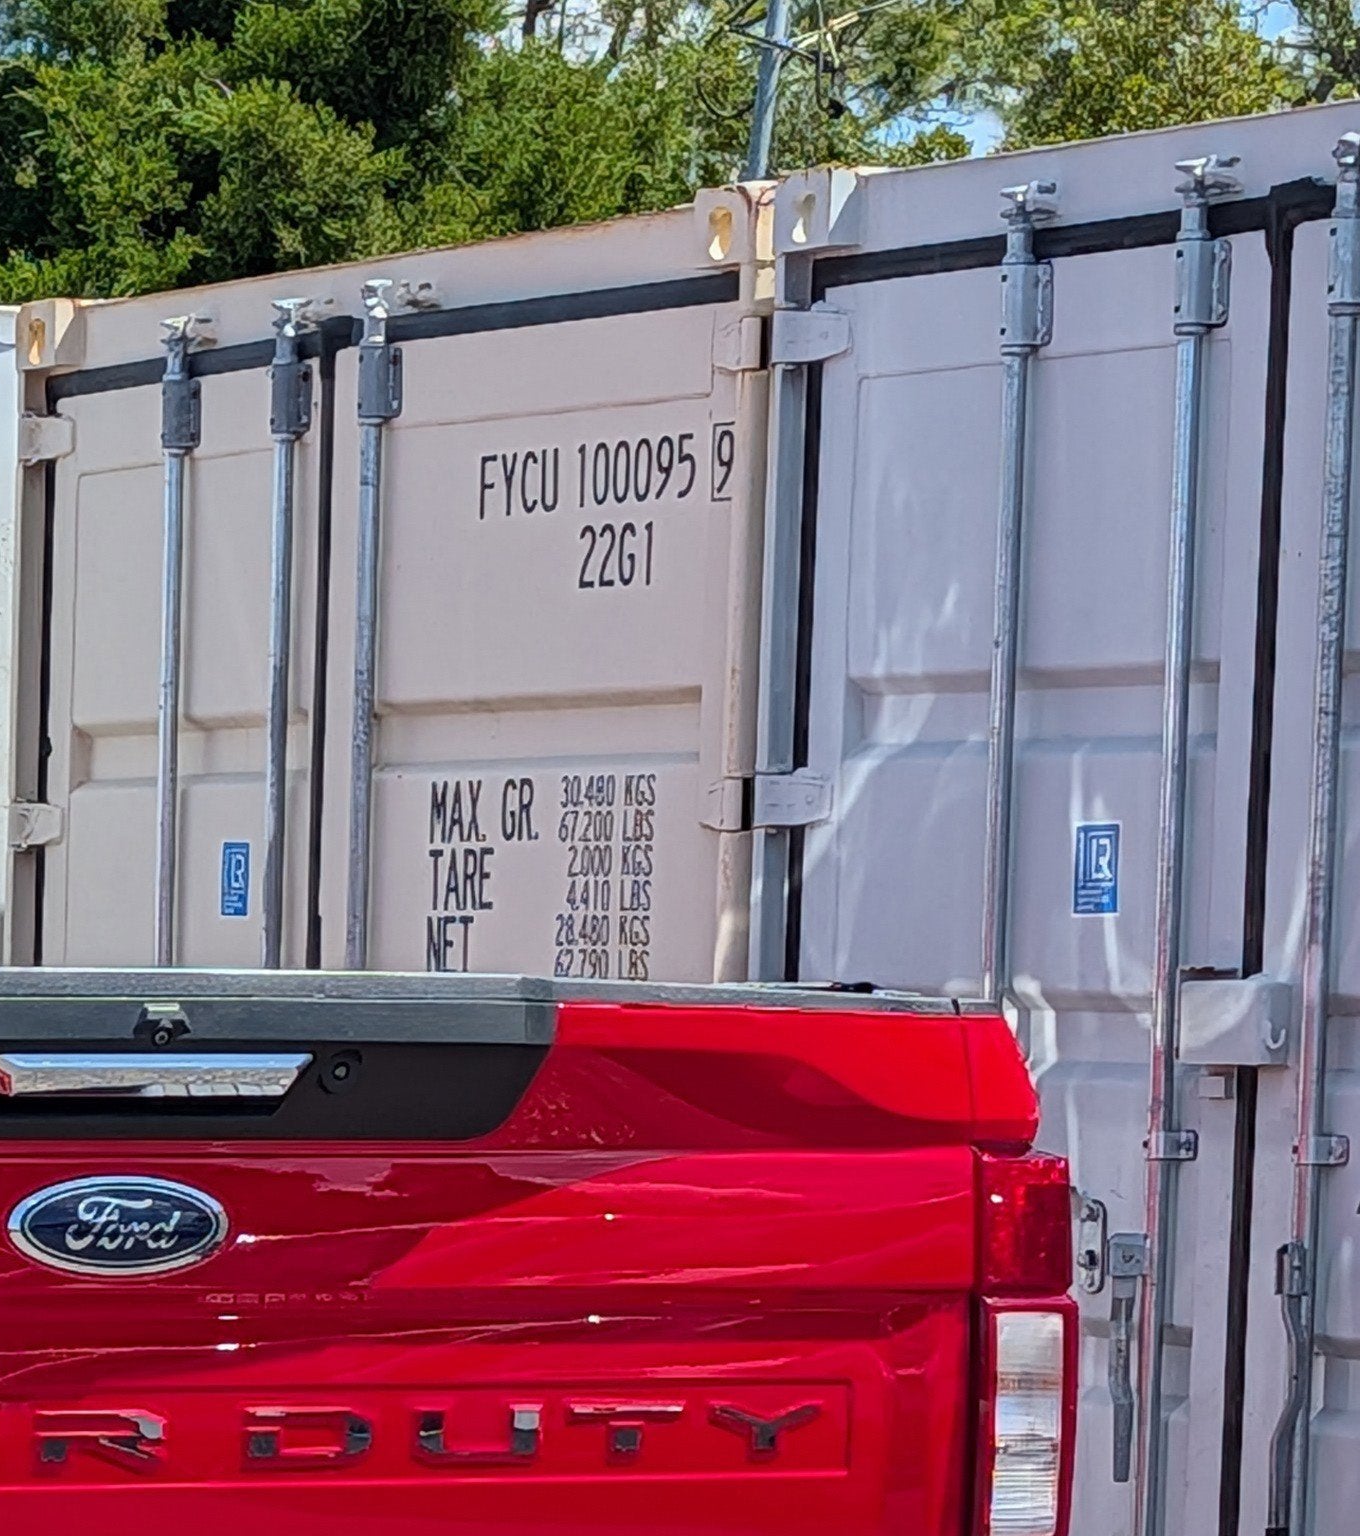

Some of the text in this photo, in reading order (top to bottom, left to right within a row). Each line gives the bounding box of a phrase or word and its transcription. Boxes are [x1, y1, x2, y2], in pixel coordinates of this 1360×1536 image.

[480, 430, 735, 519] FYCU 100095 9
[579, 520, 654, 588] 22G1
[430, 780, 487, 843] MAX.
[501, 778, 539, 841] GR.
[623, 774, 656, 806] KGS
[622, 809, 655, 842] LBS
[429, 847, 494, 911] TARE
[621, 845, 653, 877] KGS
[620, 879, 652, 911] LBS
[426, 915, 474, 972] NET
[618, 914, 650, 946] KGS
[65, 1196, 181, 1250] Ford
[243, 1400, 823, 1473] DUTY
